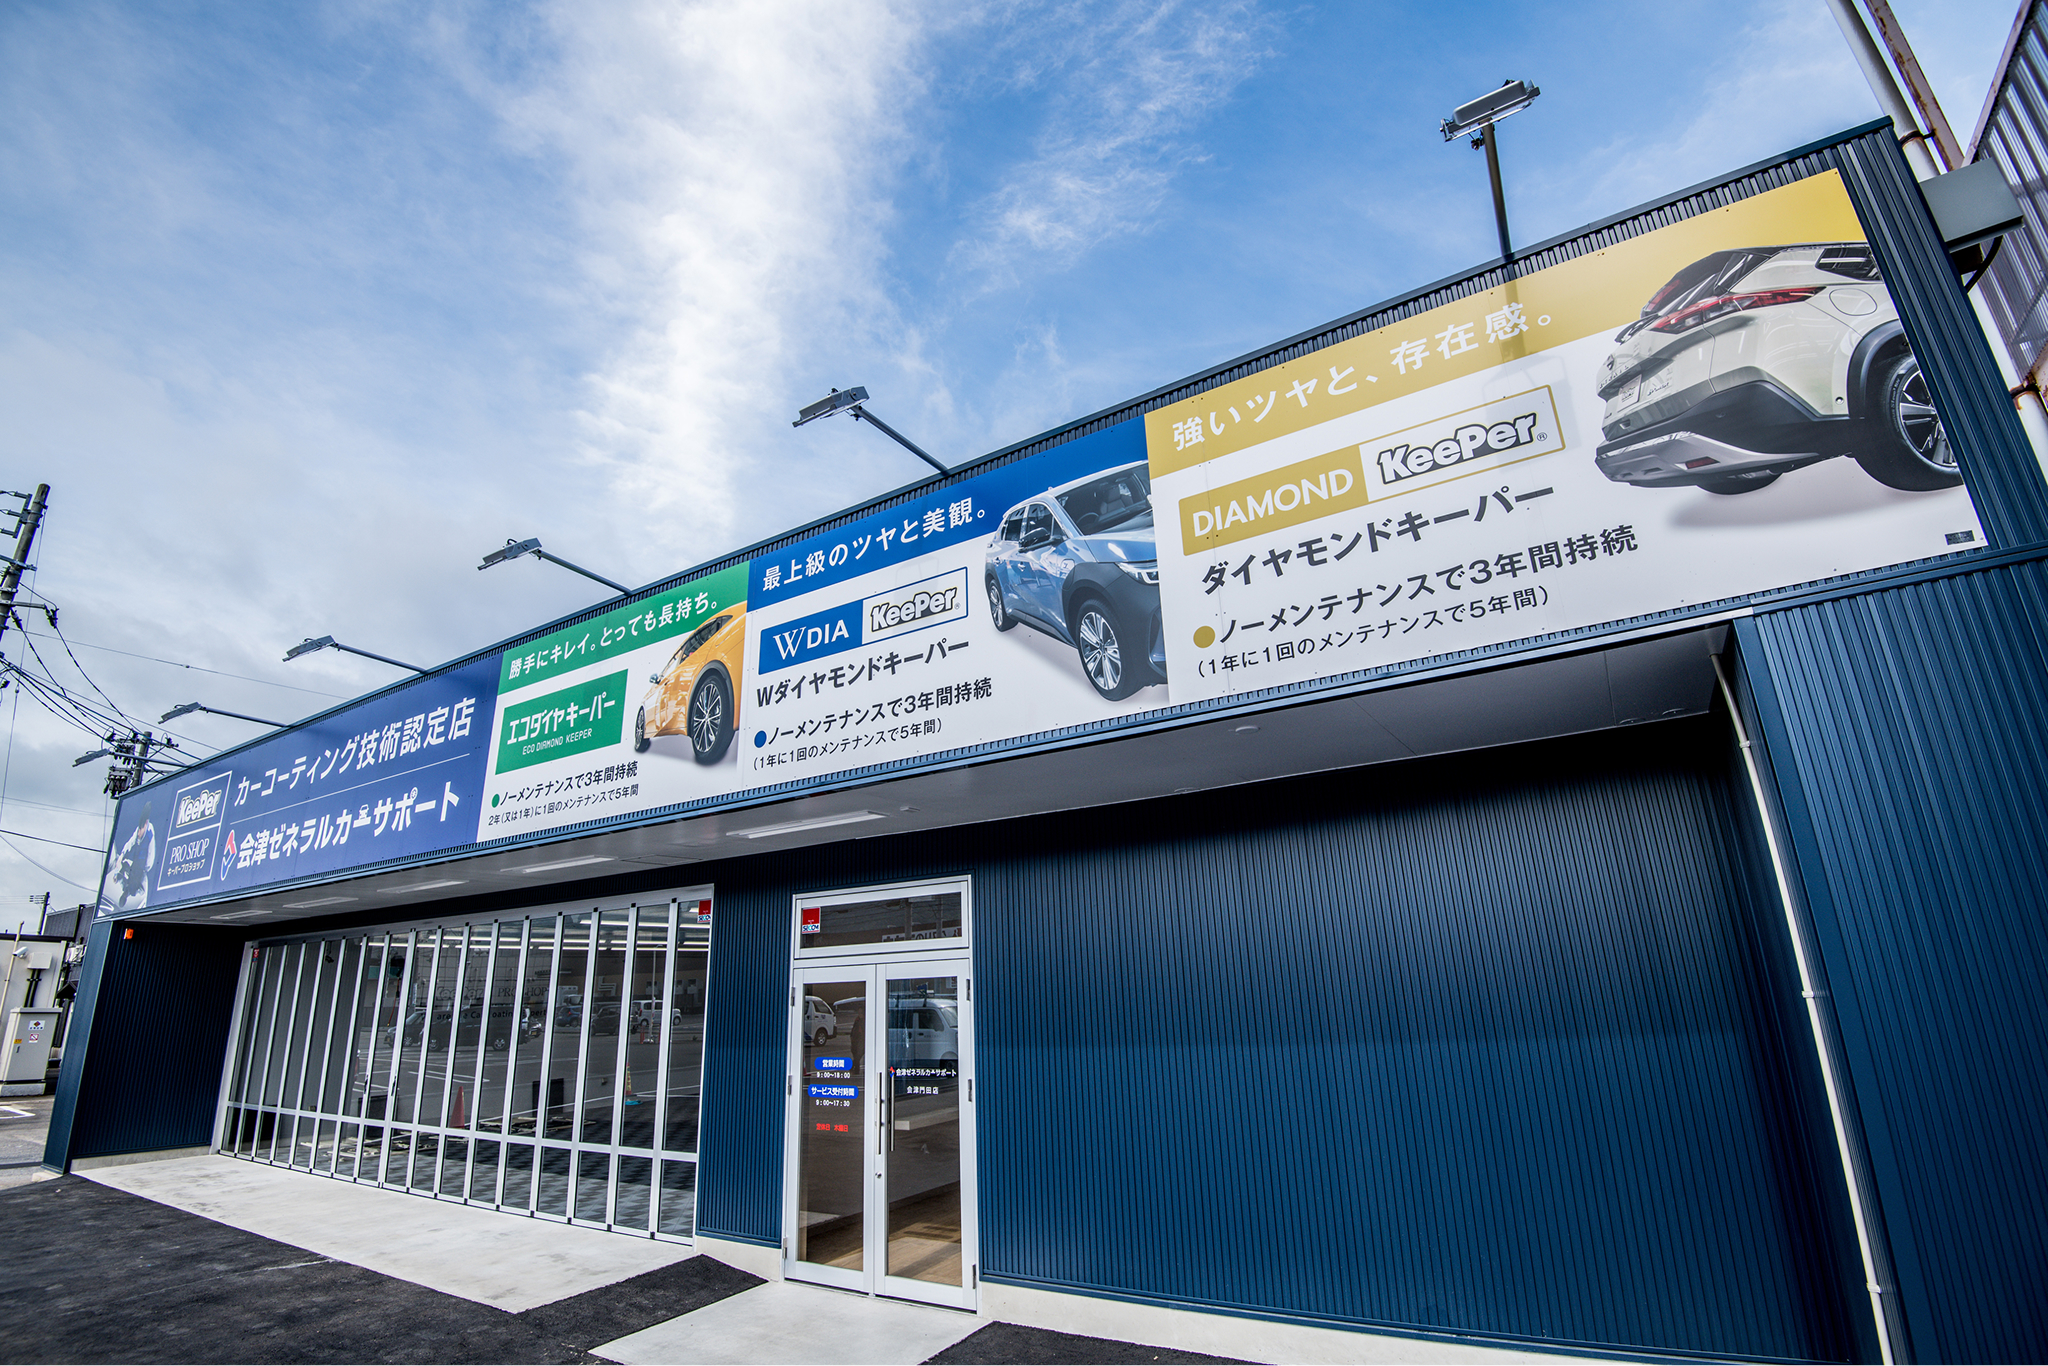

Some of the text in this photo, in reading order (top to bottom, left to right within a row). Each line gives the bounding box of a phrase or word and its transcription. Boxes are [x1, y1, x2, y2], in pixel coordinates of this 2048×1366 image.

[1172, 301, 1552, 452] 強いツヤと、存在感。
[1193, 467, 1354, 538] DIAMOND
[762, 497, 986, 592] 最上級のツヤと美観。
[1201, 485, 1554, 595] ダイヤモンドキーパー
[1218, 524, 1638, 644] ノーメンテナンスで3年間持続
[509, 591, 718, 680] 勝手にキレイ。とっても長持ち。
[756, 637, 970, 708] Wダイヤモンドキーパー
[507, 692, 616, 746] エコダイヤキーパー
[522, 728, 592, 755] ECO DIAMOND KEEPER
[769, 677, 993, 746] ノーメンテナンスで3年間持続
[233, 697, 477, 807] カーコーティング技術認定店
[500, 760, 639, 807] ノーメンテナンスで3年間持続
[170, 838, 210, 864] PRO SHOP
[236, 781, 461, 870] 会津ゼネラルカーサポート
[167, 858, 206, 877] キーパープロショップ
[811, 1087, 855, 1097] サービス受付時間
[896, 1068, 957, 1077] 会津ゼネラルカーサポート
